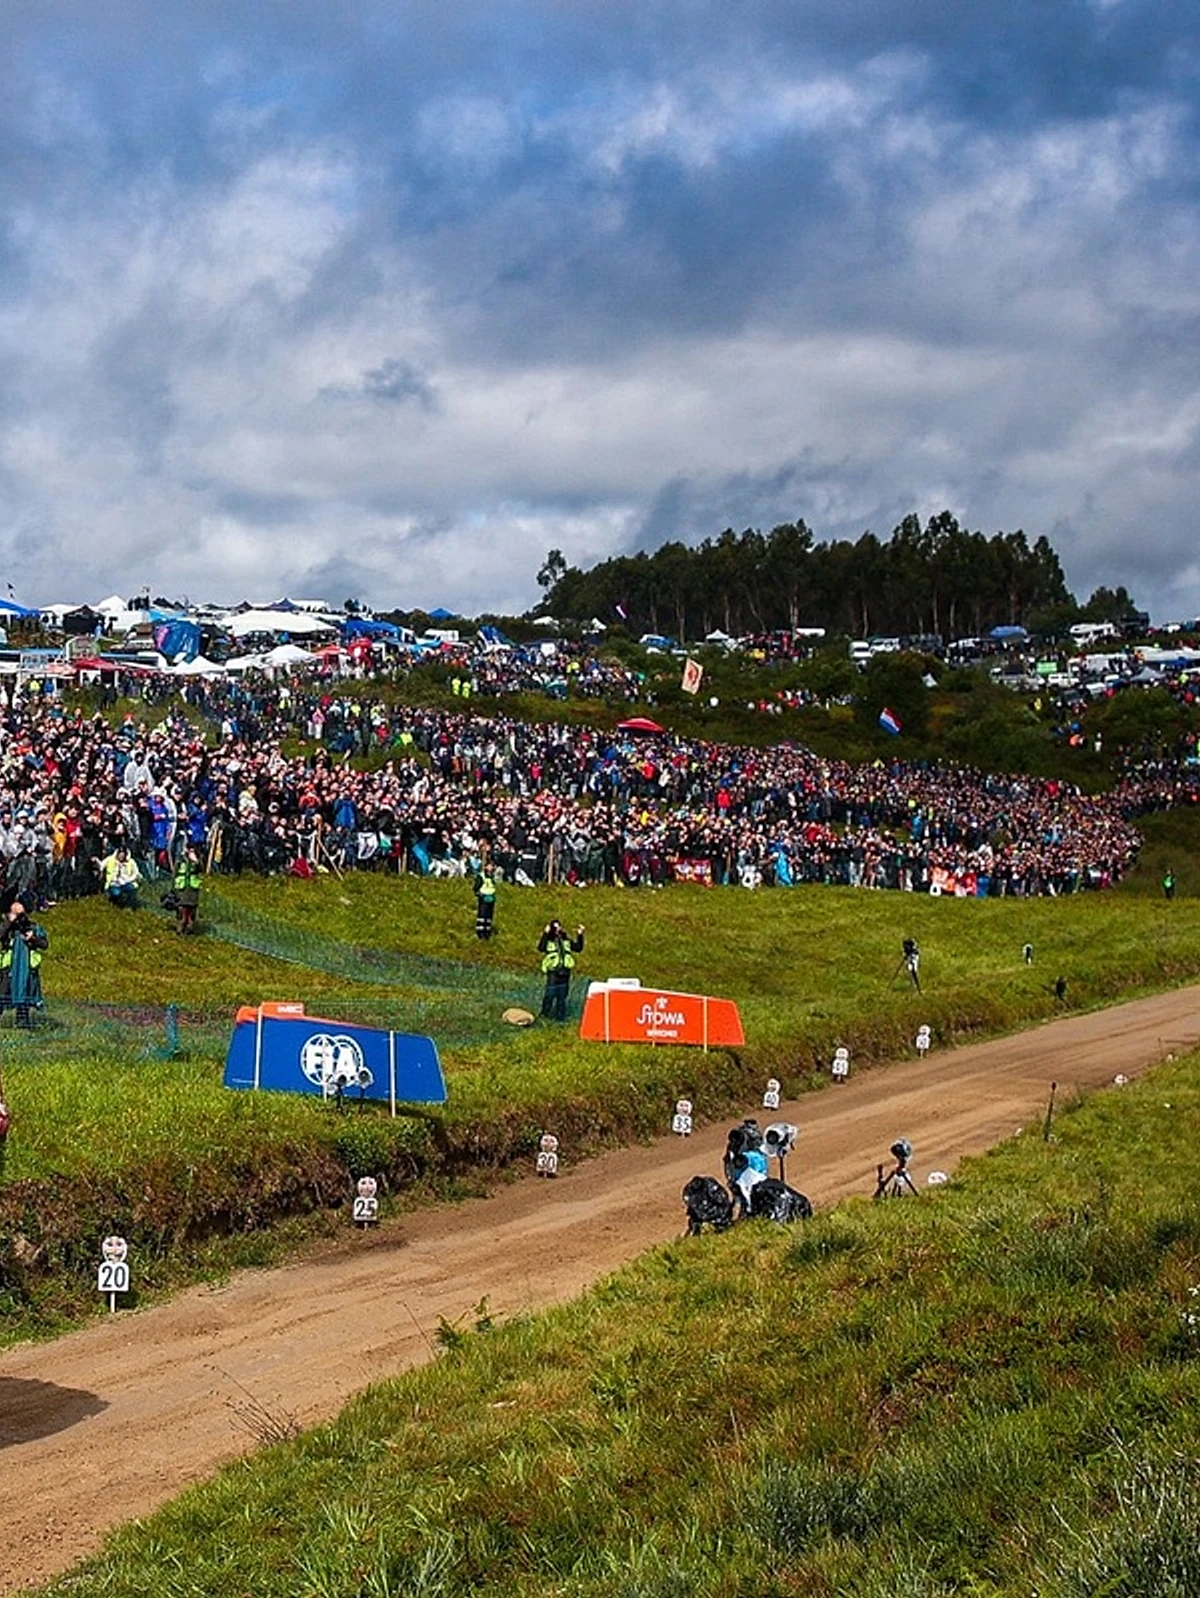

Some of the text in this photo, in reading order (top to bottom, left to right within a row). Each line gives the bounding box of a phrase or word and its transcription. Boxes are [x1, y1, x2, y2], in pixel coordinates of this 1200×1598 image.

[676, 1116, 689, 1130] 35
[356, 1200, 375, 1217] 25
[102, 1265, 126, 1288] 20
